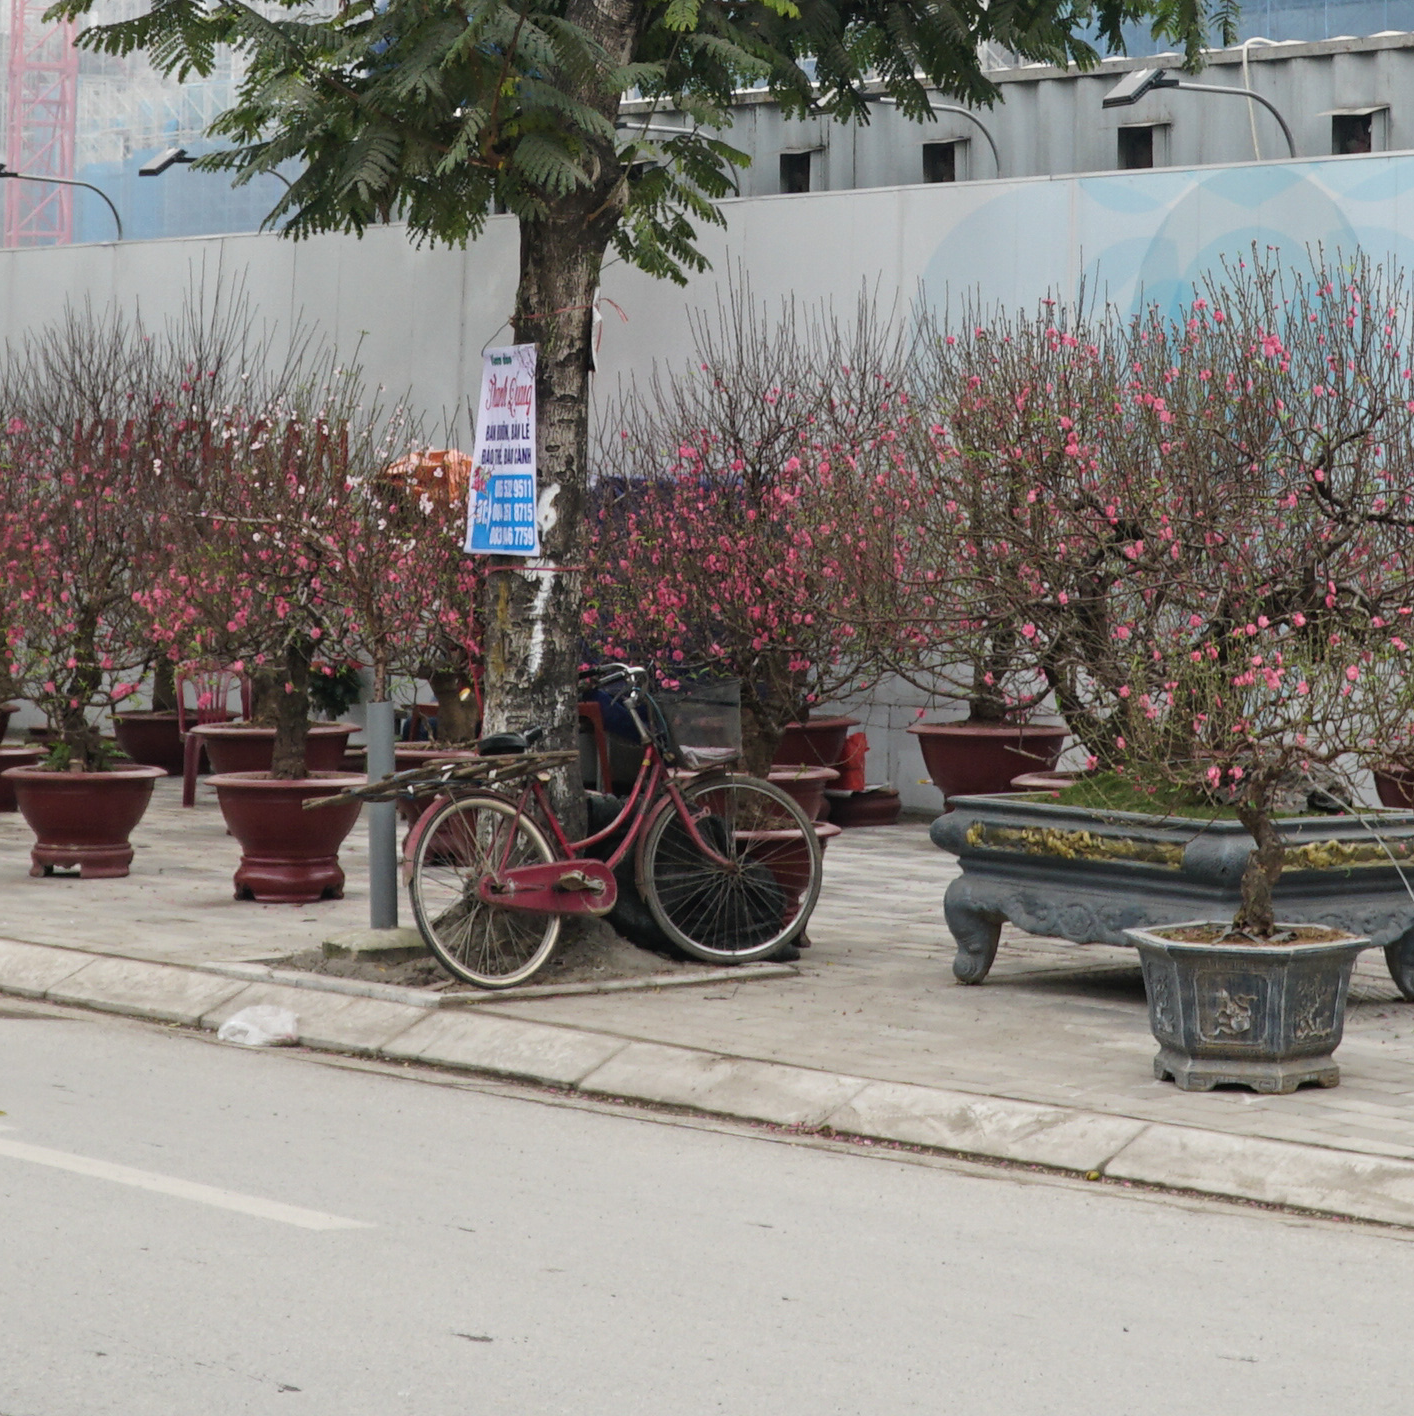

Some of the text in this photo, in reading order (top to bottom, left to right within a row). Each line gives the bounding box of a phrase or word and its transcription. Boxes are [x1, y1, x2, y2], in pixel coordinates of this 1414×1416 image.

[513, 479, 532, 498] 9511
[513, 502, 533, 522] 8715
[514, 526, 534, 546] 7759
